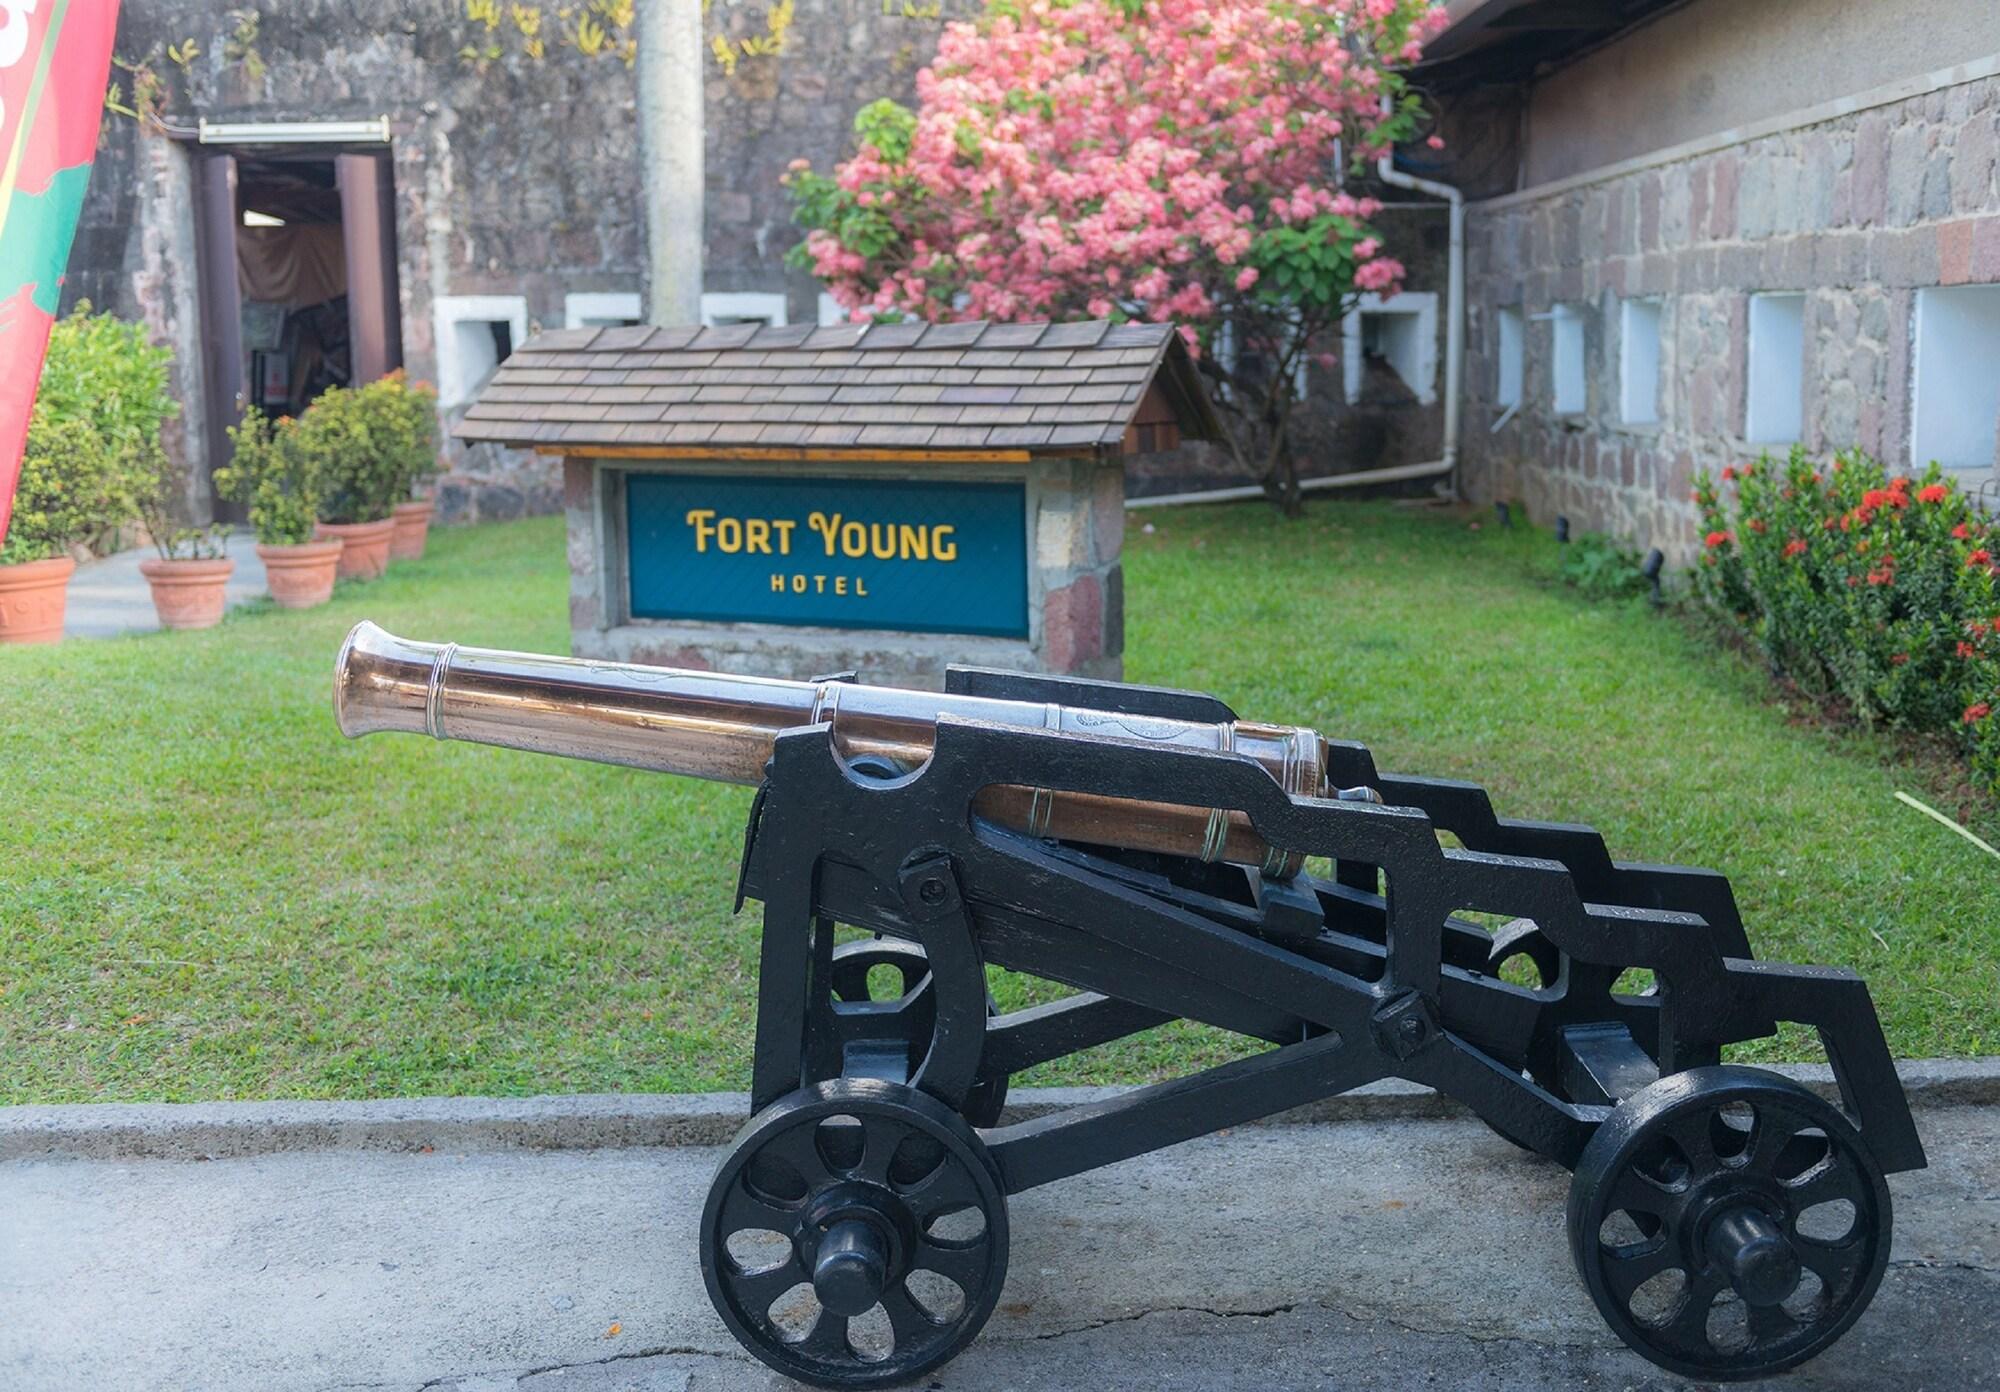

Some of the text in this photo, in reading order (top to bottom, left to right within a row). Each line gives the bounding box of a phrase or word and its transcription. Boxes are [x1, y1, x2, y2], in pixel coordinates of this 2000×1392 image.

[686, 509, 957, 562] FORT YOUNG
[770, 574, 868, 596] HOTEL
